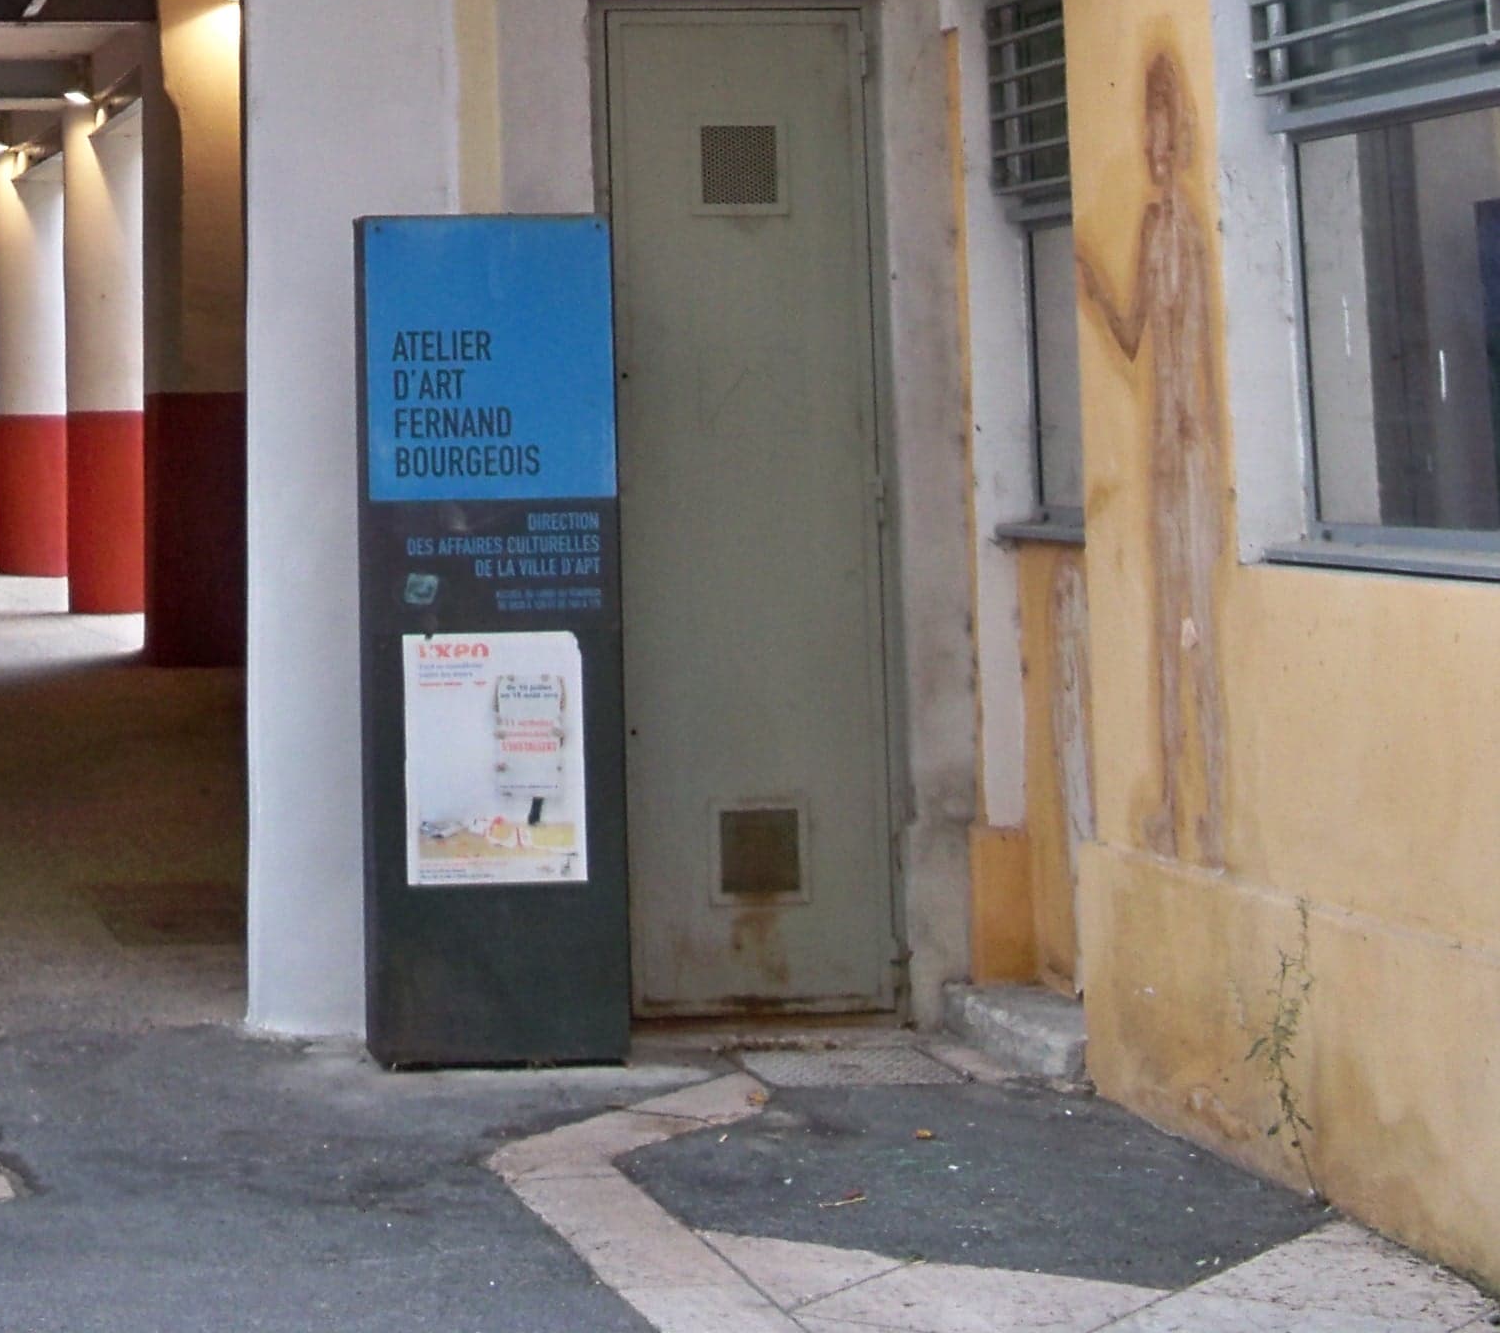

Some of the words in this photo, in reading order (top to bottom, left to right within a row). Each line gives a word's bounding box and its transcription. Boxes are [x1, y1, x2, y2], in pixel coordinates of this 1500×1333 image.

[392, 330, 492, 362] ATELIER
[393, 368, 466, 400] D'ART
[394, 406, 512, 439] FERNAND
[395, 443, 541, 478] BOURGEOIS
[528, 511, 599, 532] DIRECTION
[407, 537, 434, 556] DES
[438, 535, 501, 555] AFFAIRES
[507, 533, 600, 554] CULTURELLES
[475, 558, 493, 578] DE
[497, 558, 516, 577] LA
[519, 557, 557, 576] VILLE
[561, 555, 600, 575] D'APT
